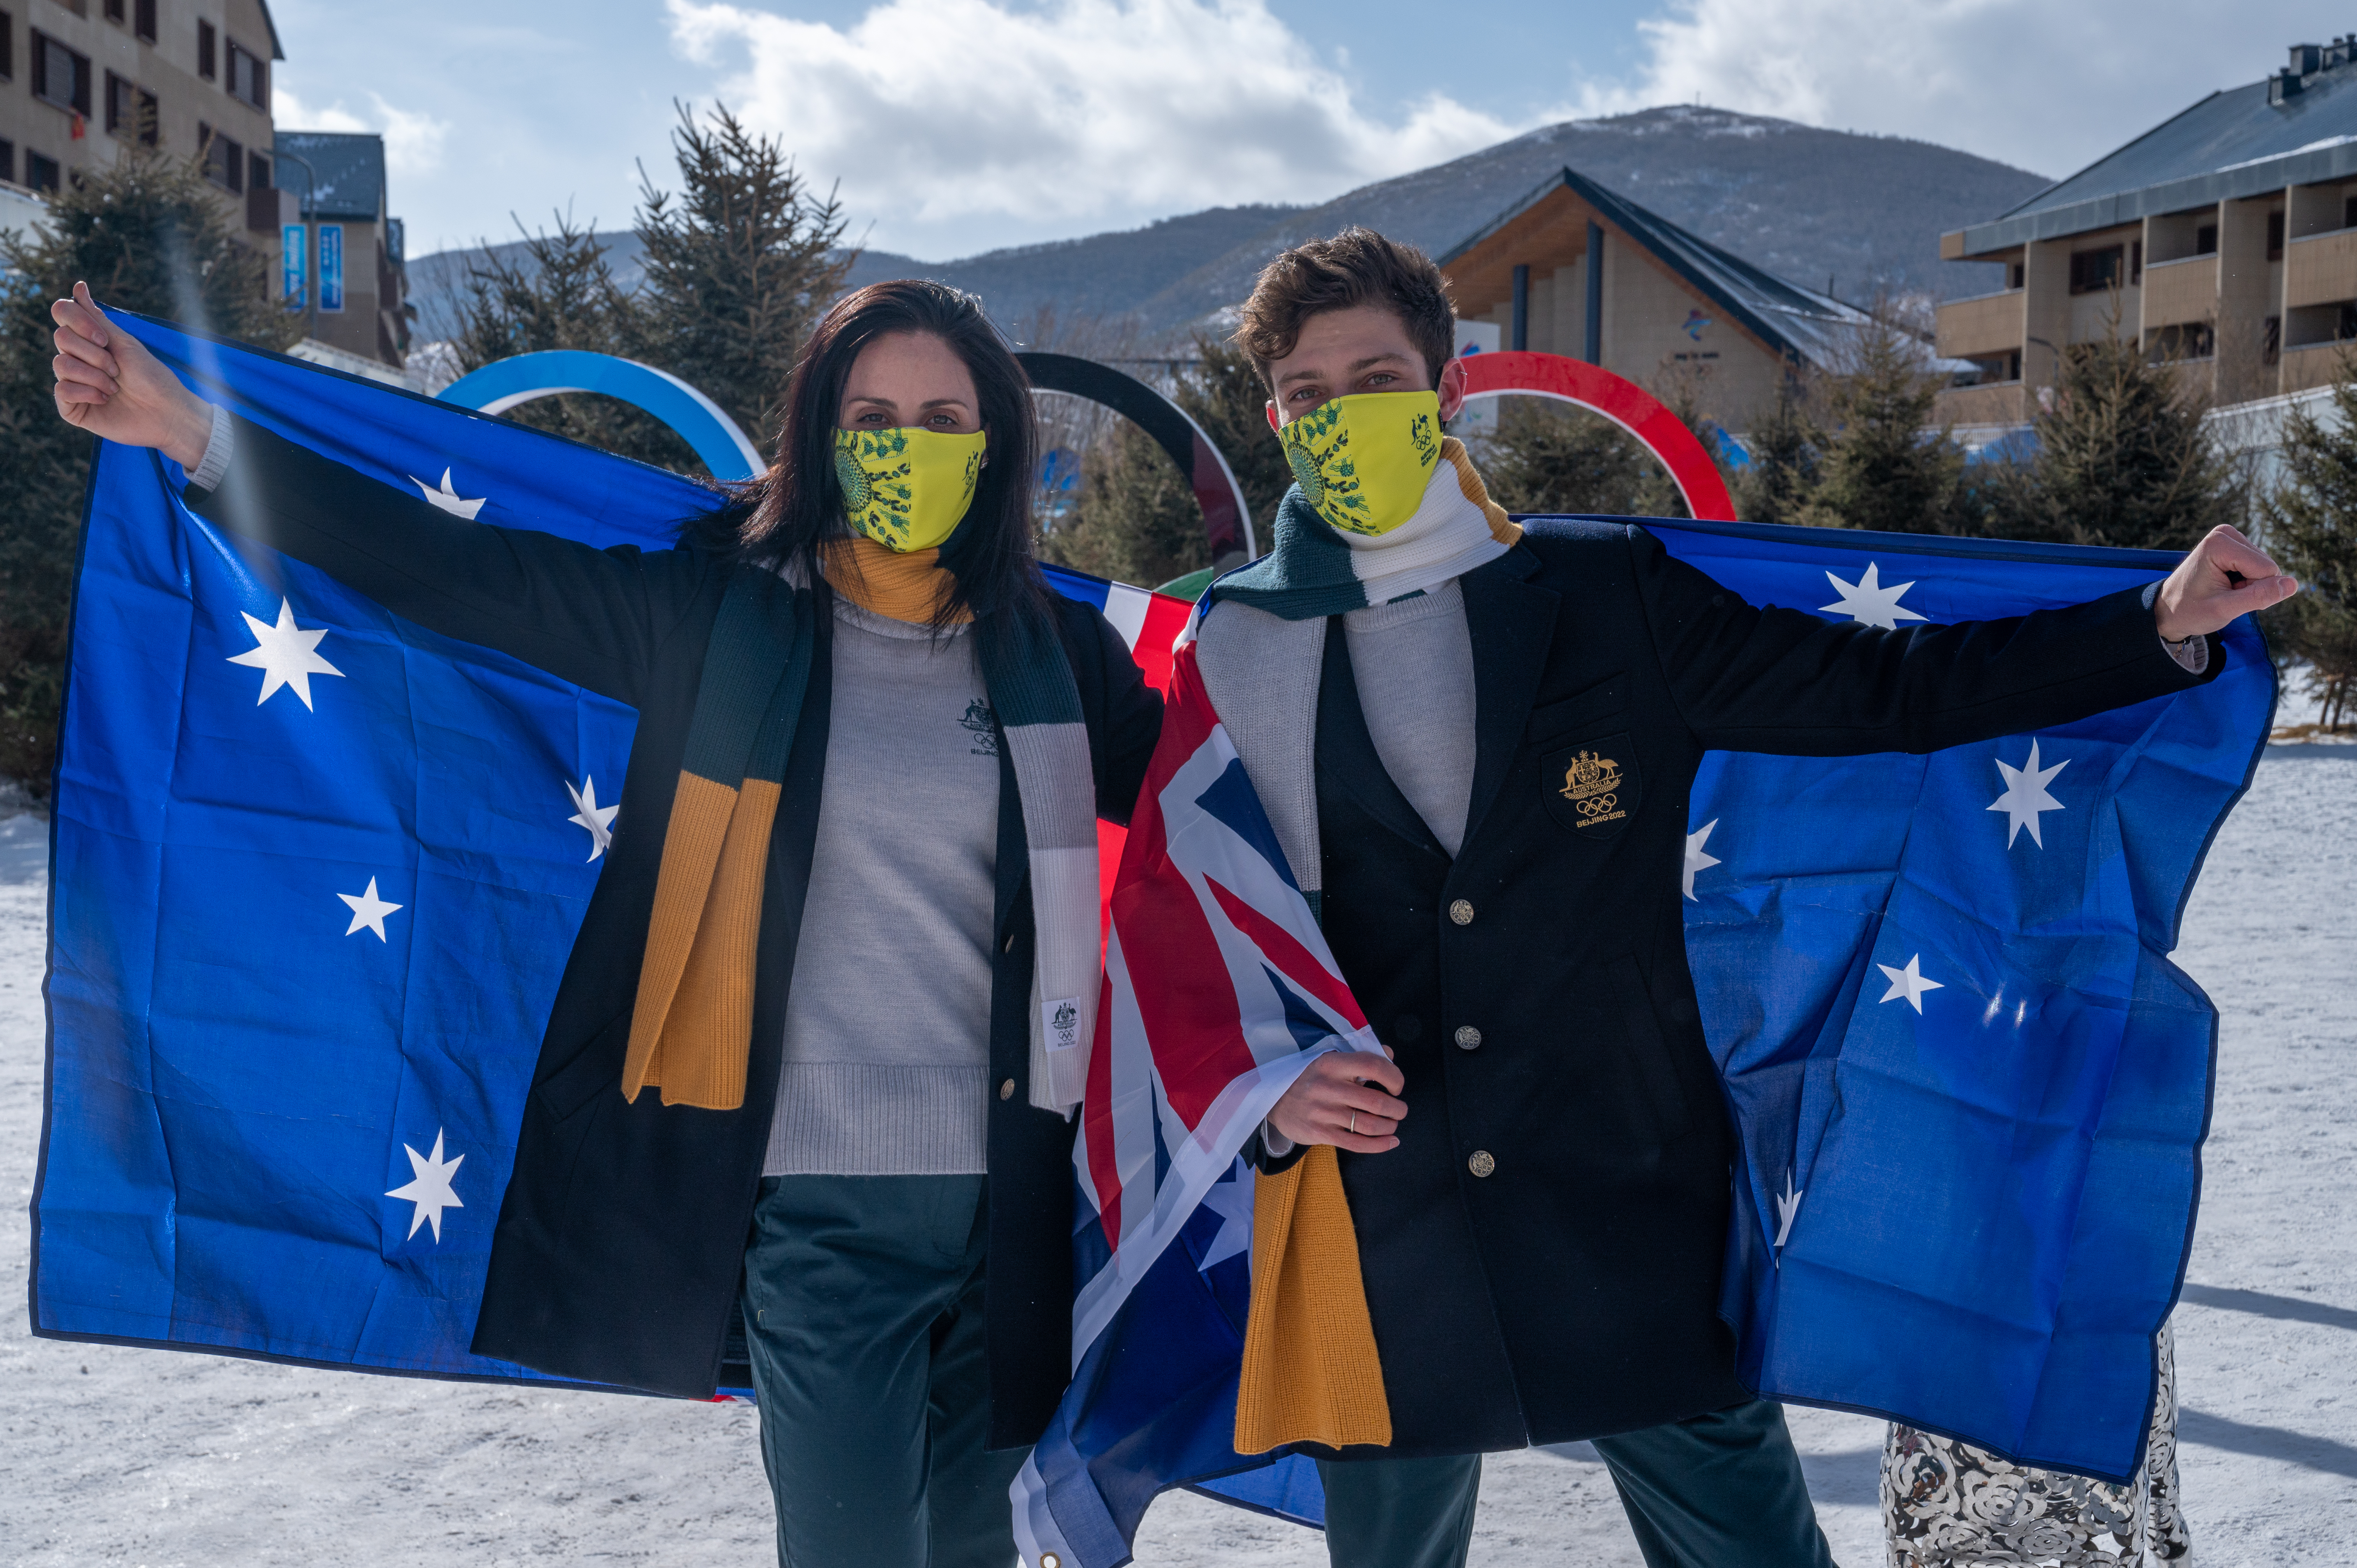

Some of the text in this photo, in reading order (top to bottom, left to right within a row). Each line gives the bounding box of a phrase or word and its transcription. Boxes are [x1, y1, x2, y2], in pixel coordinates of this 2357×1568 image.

[1421, 443, 1435, 461] AUSTRALIA
[1421, 454, 1432, 467] BEIJING
[970, 748, 998, 757] BEIJING
[1573, 780, 1611, 794] AUSTRALIA
[1576, 810, 1626, 828] BEIJING 2022
